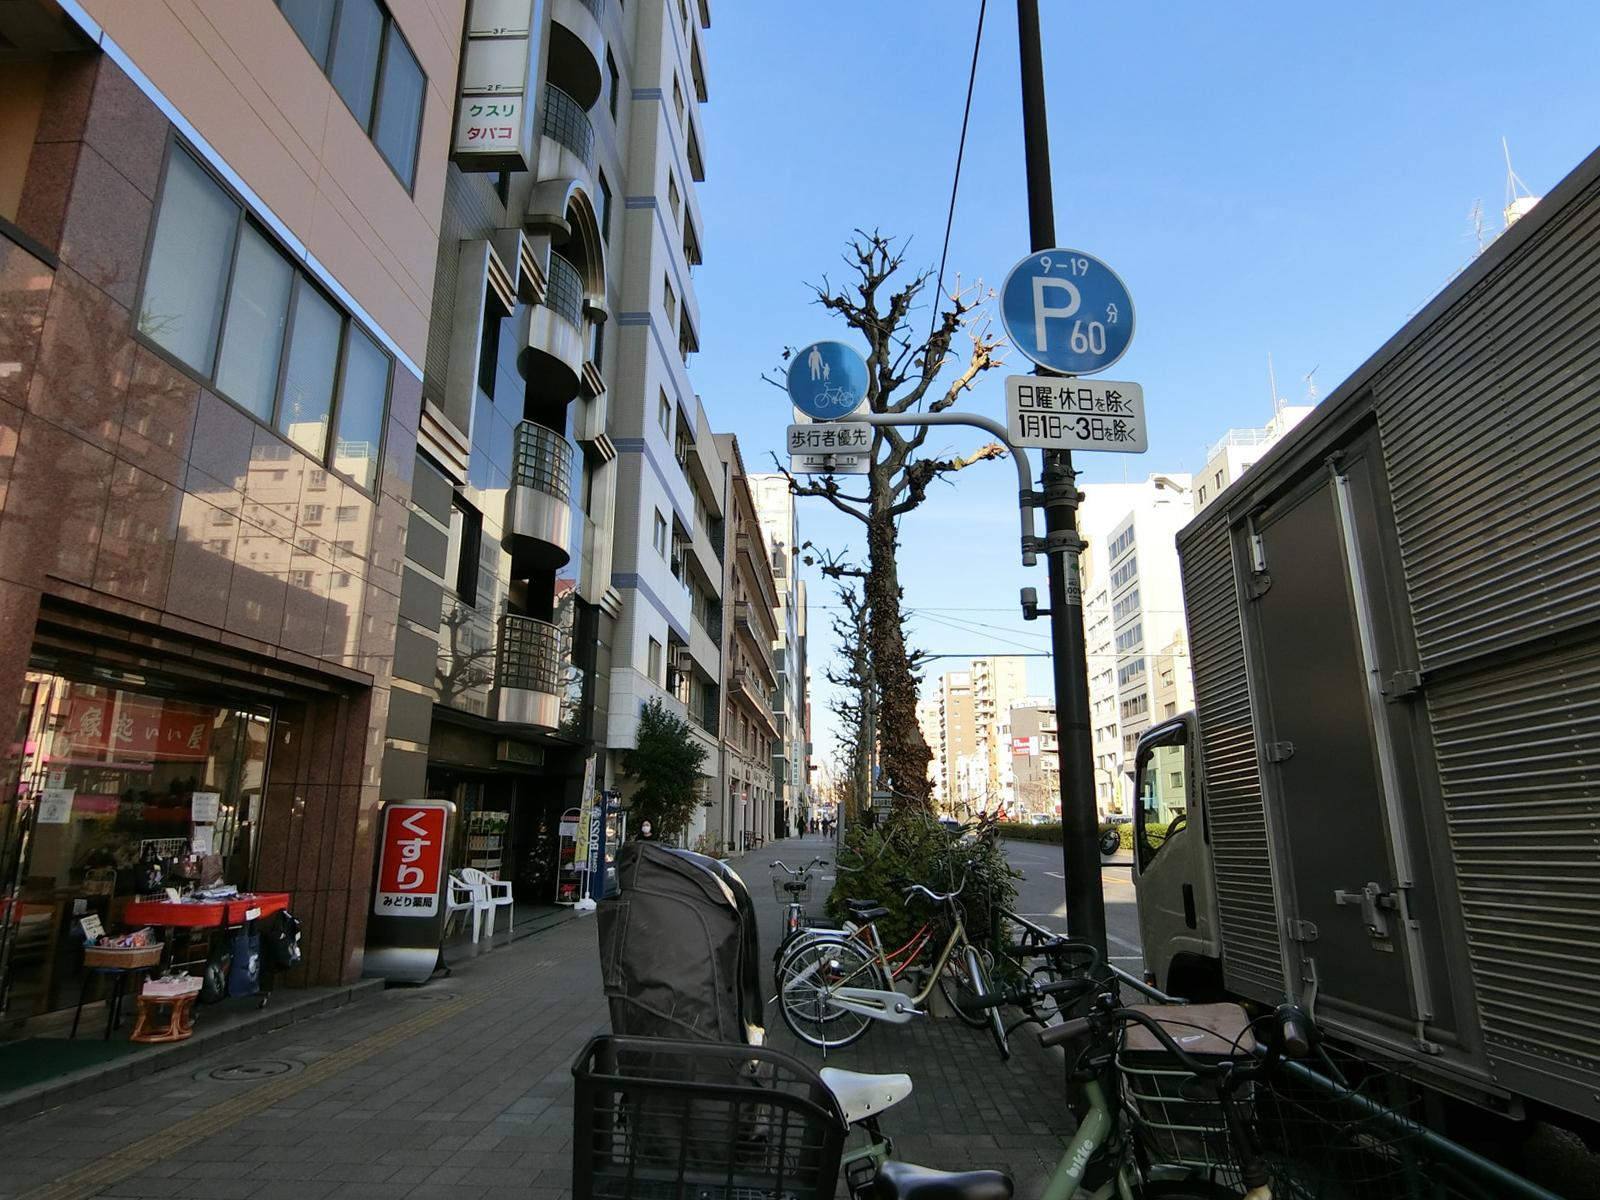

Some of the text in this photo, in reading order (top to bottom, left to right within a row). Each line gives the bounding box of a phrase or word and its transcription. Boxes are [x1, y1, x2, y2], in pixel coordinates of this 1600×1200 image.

[469, 104, 515, 117] クスリ
[467, 126, 513, 140] タバコ
[1039, 256, 1089, 276] 9-19
[1032, 276, 1081, 352] P
[1018, 385, 1134, 414] 日曜・休日を除く
[791, 428, 867, 449] 歩行者優先
[79, 705, 206, 750] 縁起いい屋
[590, 819, 601, 851] BOSS
[396, 810, 432, 891] くすり
[383, 896, 433, 909] みどり薬局
[1066, 1139, 1094, 1178] bikke
